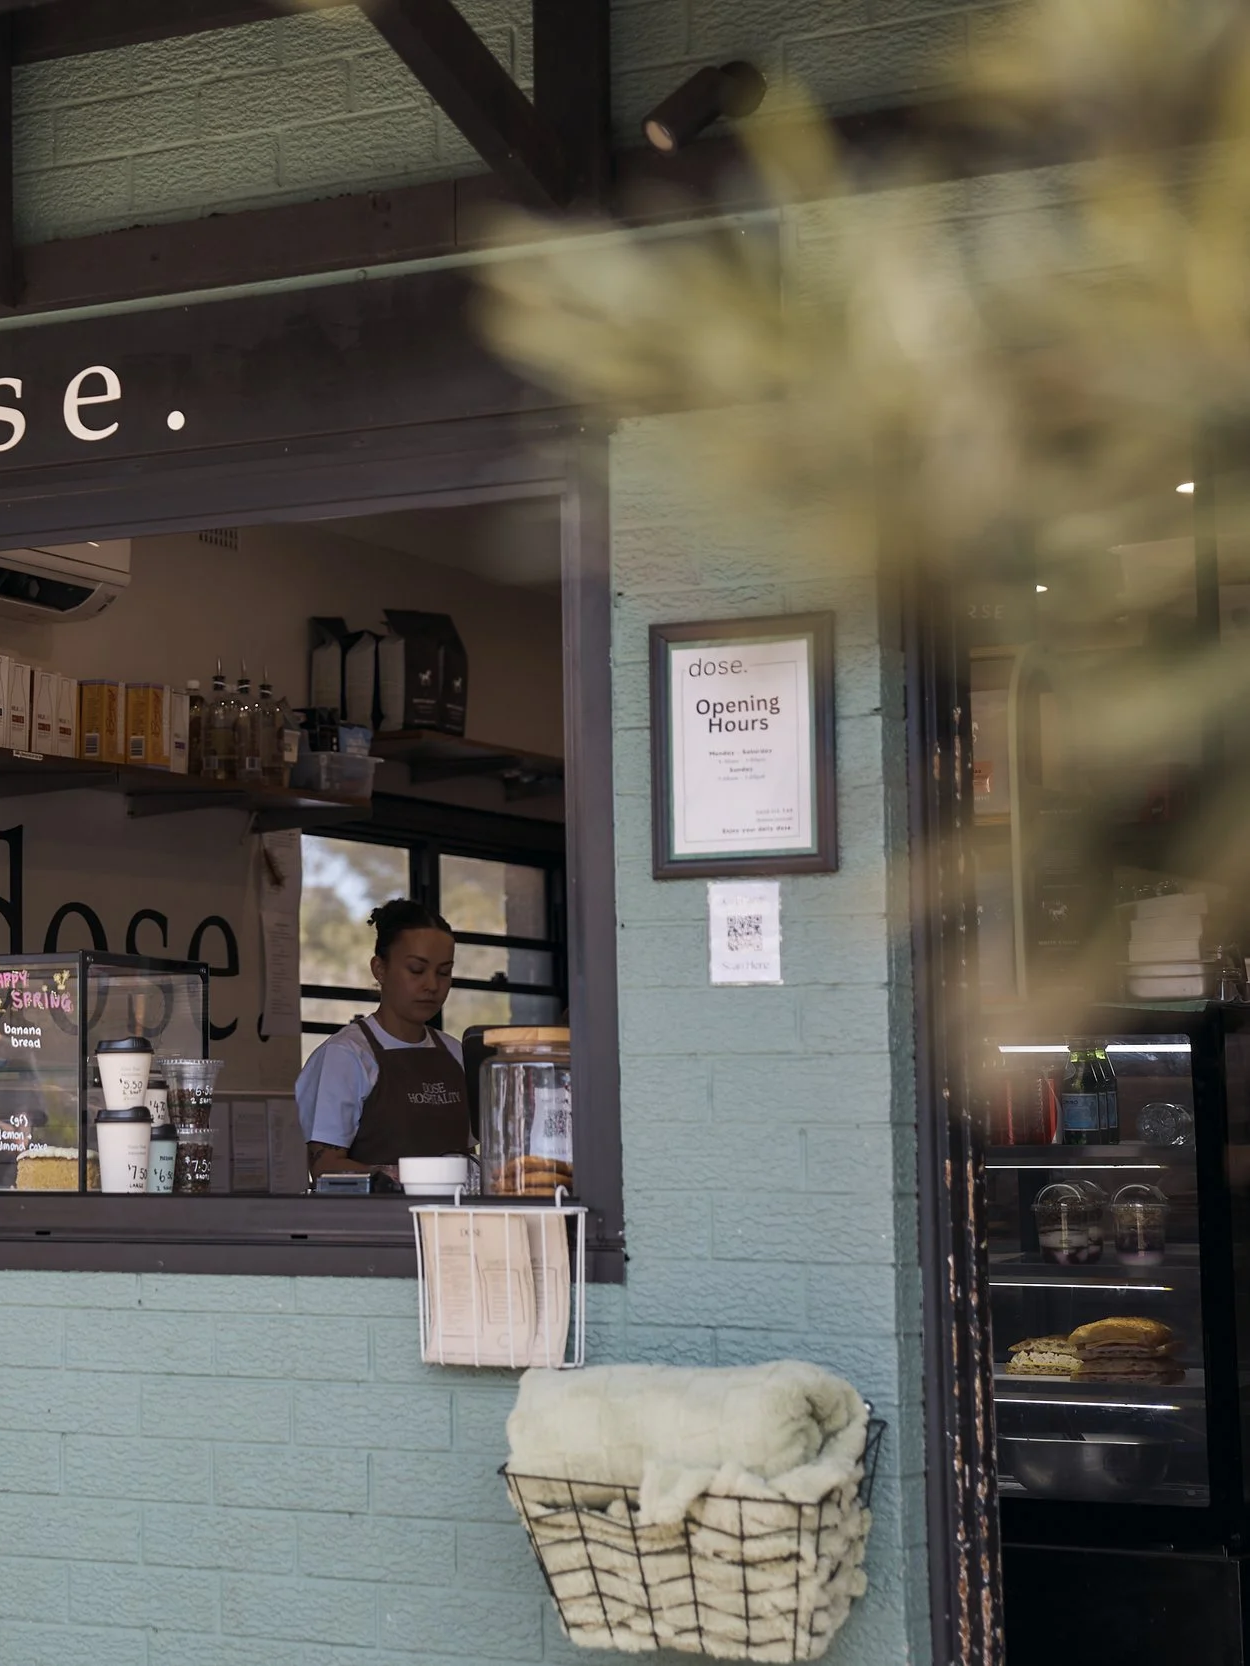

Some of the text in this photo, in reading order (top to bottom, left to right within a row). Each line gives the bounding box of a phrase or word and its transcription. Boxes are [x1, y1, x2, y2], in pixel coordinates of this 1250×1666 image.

[688, 657, 748, 678] dose.
[696, 694, 781, 718] Opening
[708, 716, 769, 734] Hours
[10, 990, 75, 1013] SPRING
[4, 1023, 42, 1036] banana
[11, 1036, 42, 1049] bread
[422, 1082, 446, 1094] DOSE
[407, 1091, 462, 1105] HOSPITALITY
[9, 1114, 29, 1128] (gf)
